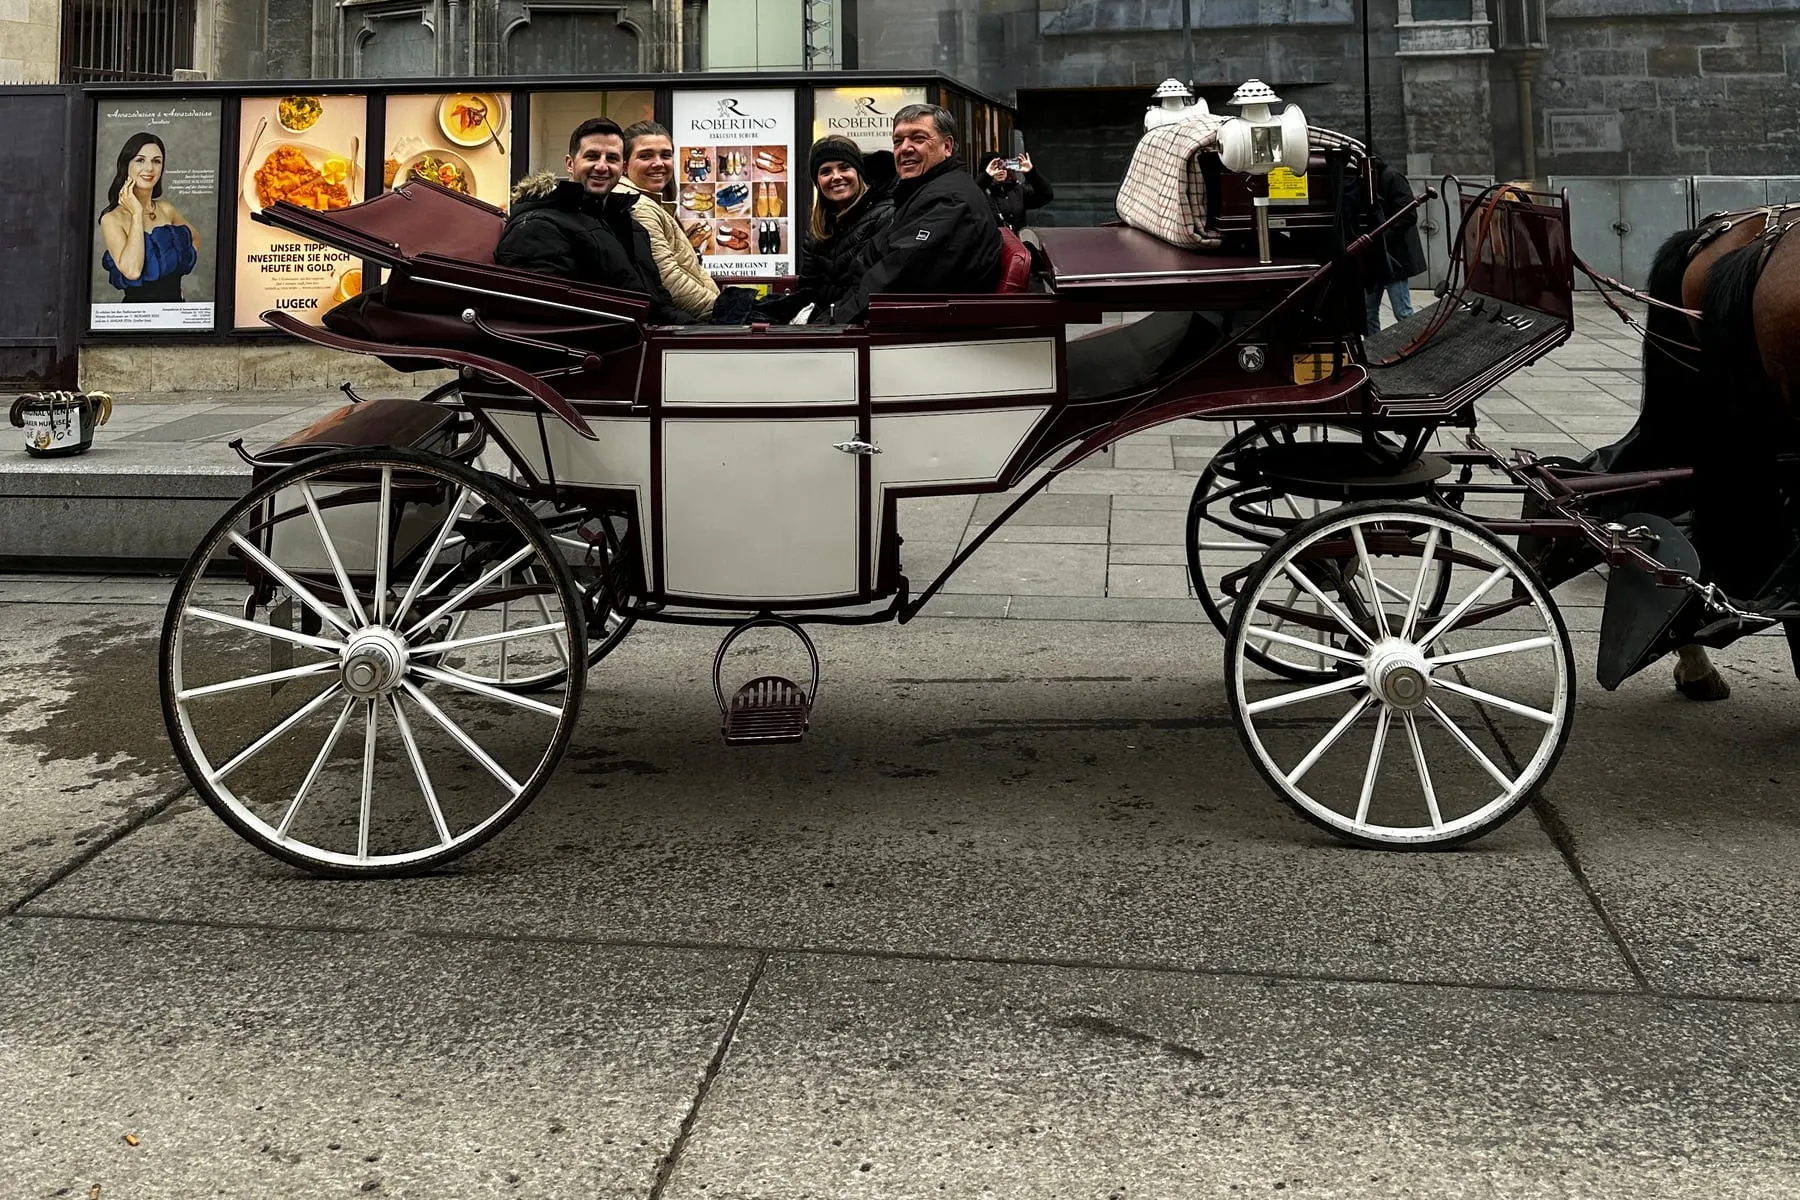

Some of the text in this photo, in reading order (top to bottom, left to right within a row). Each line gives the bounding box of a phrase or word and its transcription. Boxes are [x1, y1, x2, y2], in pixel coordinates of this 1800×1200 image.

[691, 118, 777, 130] ROBERTINO
[828, 117, 894, 129] ROBERTI
[271, 244, 301, 252] UNSER
[247, 253, 350, 263] INVESTIEREN SIE NOCH
[261, 264, 291, 272] HEUTE
[294, 264, 304, 272] IN
[276, 299, 318, 308] LUGECK
